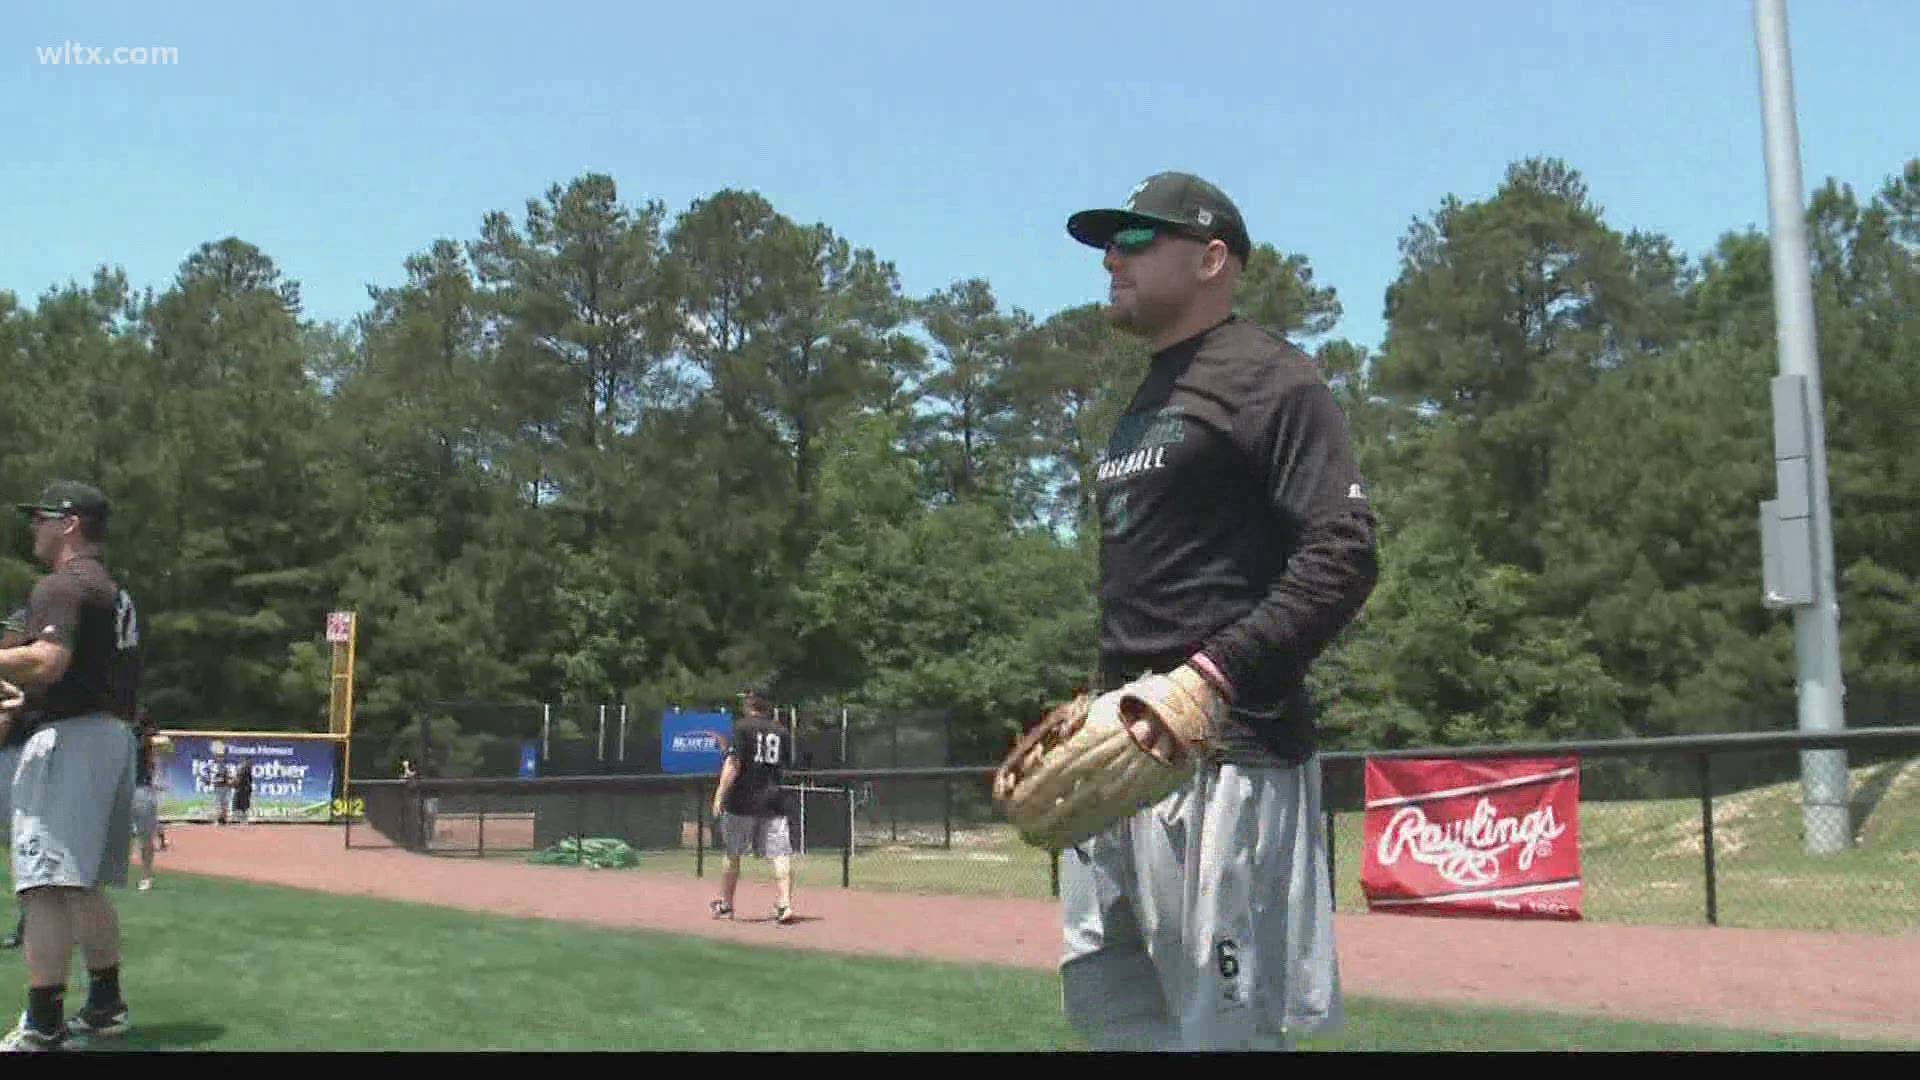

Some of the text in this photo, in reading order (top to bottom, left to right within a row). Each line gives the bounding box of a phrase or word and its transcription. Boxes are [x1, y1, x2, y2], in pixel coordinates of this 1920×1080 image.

[754, 731, 780, 764] 18
[1377, 797, 1566, 886] Rawlings
[1216, 939, 1239, 978] 6
